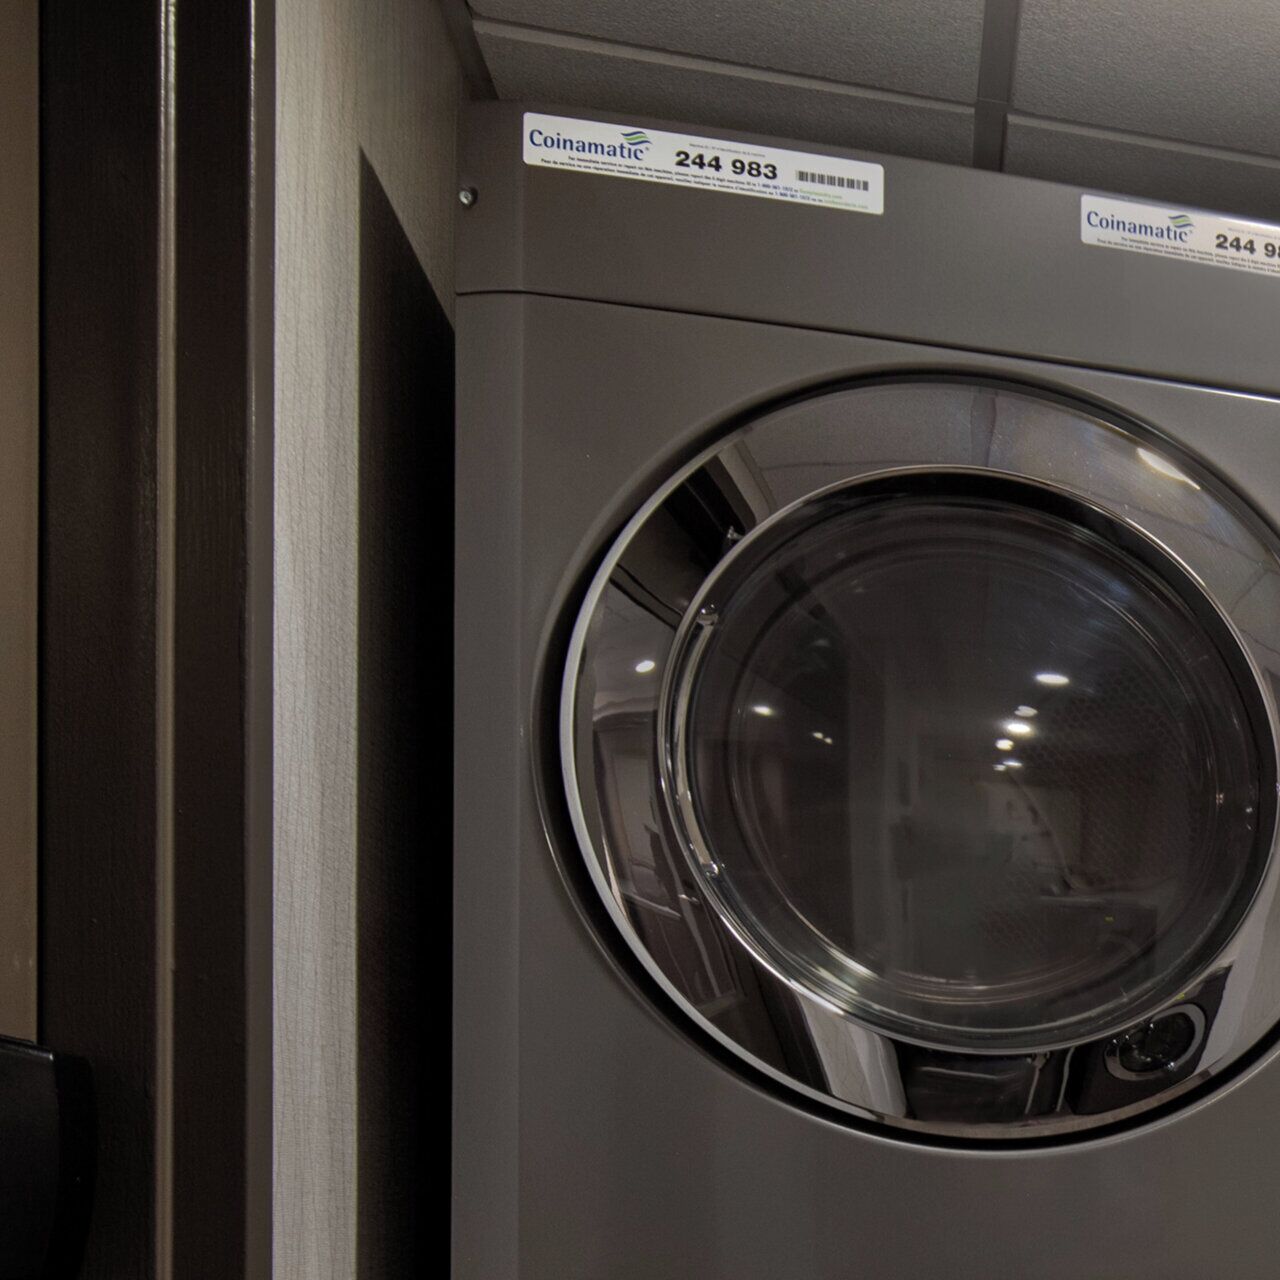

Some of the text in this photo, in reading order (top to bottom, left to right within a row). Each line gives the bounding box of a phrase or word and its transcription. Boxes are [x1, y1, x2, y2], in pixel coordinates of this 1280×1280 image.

[529, 128, 647, 161] Coinamatic
[674, 150, 778, 181] 244 983
[1087, 210, 1189, 243] Coinamatic
[1215, 233, 1256, 255] 244
